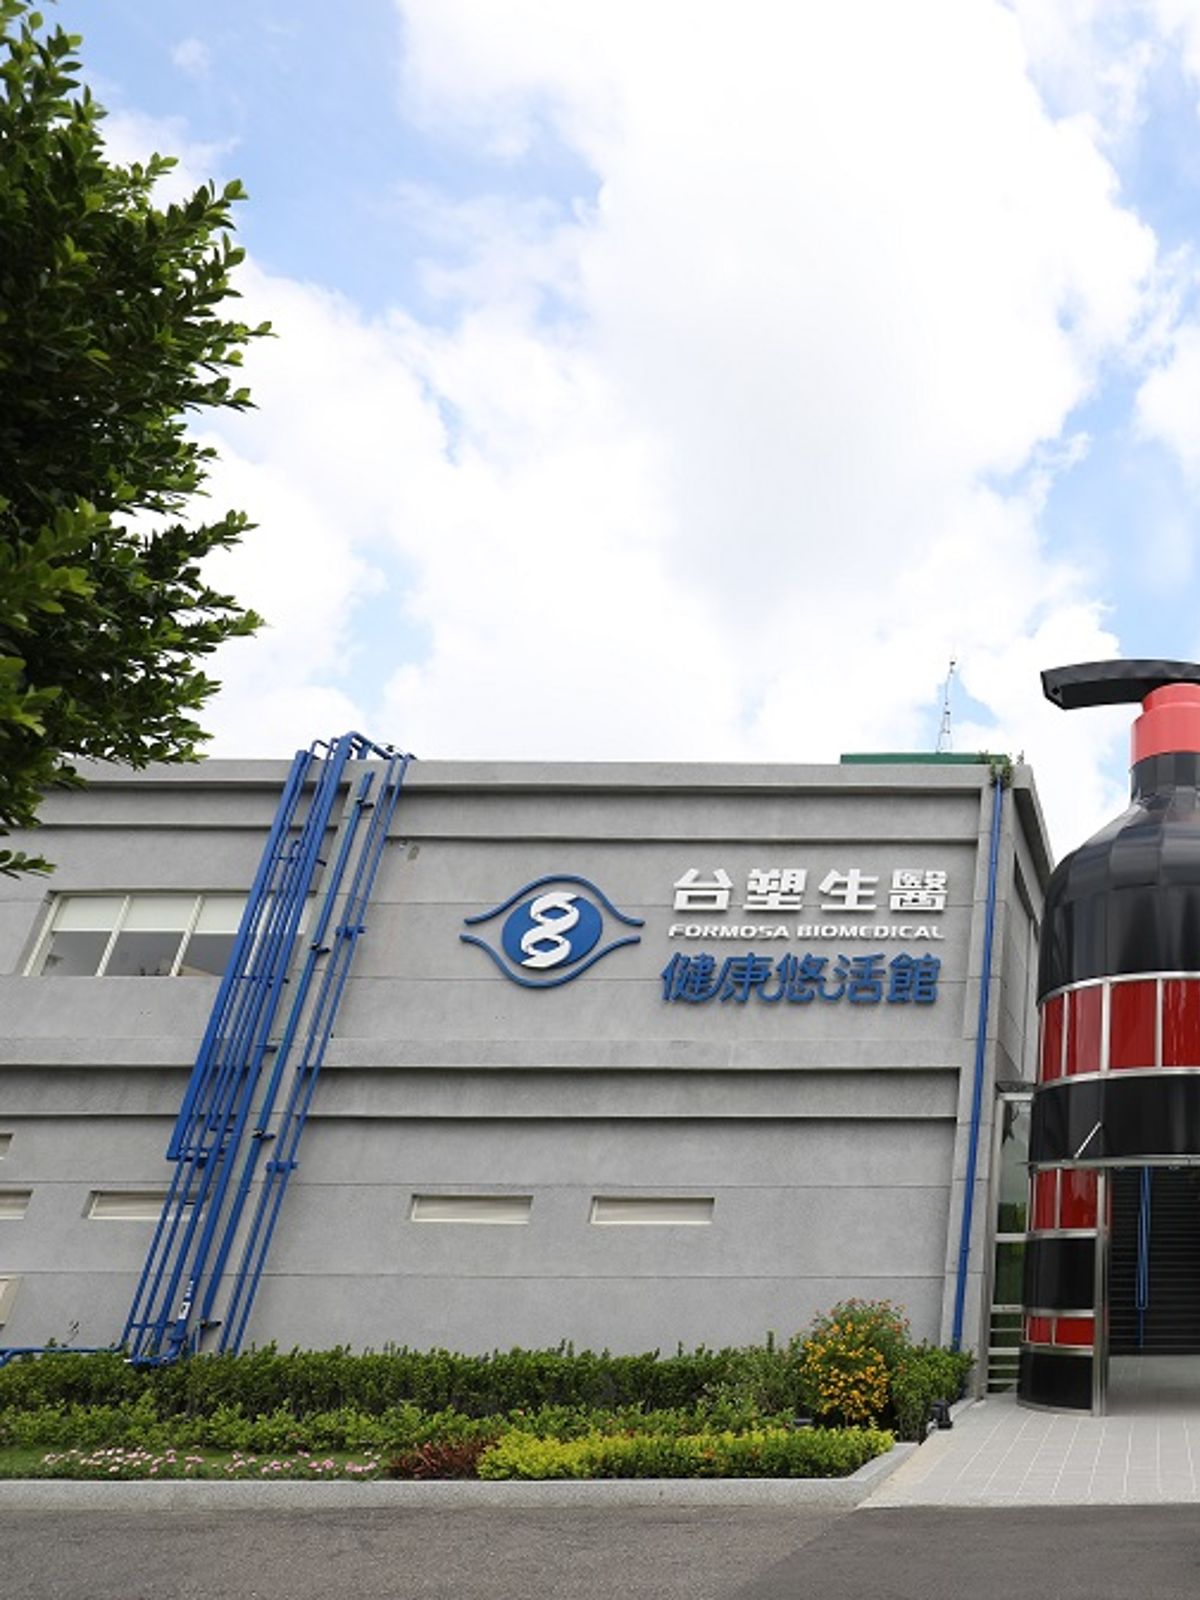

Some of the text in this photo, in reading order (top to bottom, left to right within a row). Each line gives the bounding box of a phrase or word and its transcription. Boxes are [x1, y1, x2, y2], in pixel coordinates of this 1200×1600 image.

[673, 868, 948, 911] 台塑生醫
[668, 924, 946, 939] FORMOSA BIOMEDICAL
[660, 952, 942, 1004] 健康悠活館
